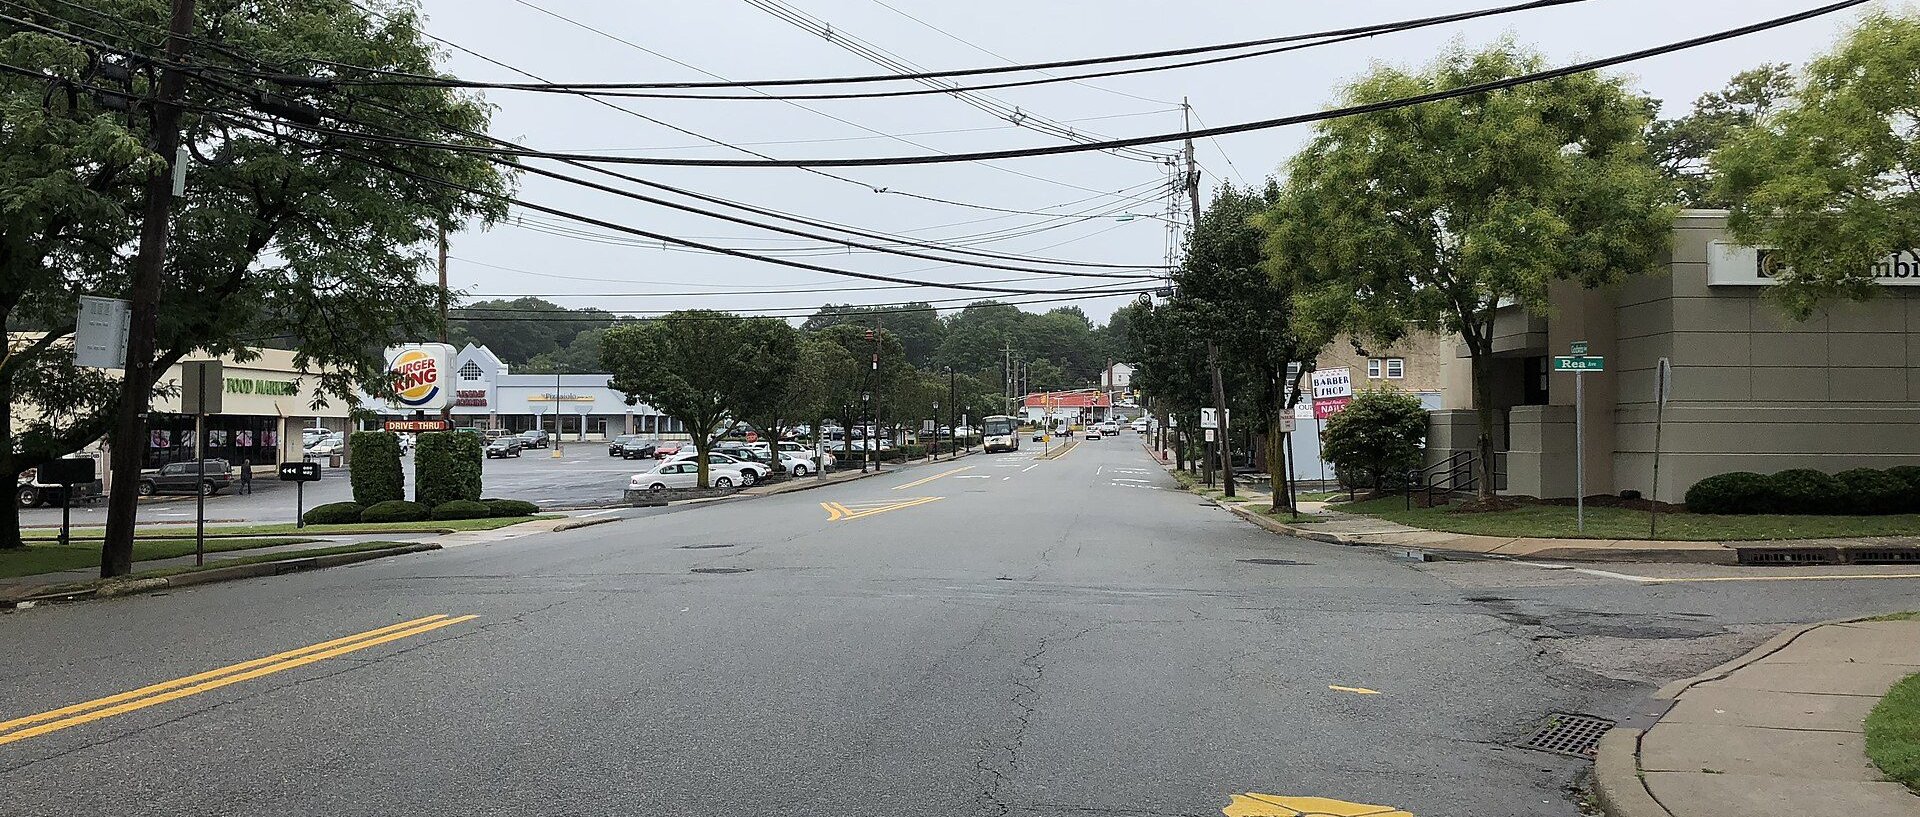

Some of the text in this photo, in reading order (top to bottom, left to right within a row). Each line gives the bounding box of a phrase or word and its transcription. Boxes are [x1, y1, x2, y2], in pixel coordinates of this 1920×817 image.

[1561, 359, 1586, 368] Rea
[393, 368, 437, 393] KING
[1313, 376, 1349, 387] BARBER
[226, 378, 254, 394] FOOD
[1321, 386, 1344, 396] SHOP
[389, 421, 440, 430] DRIVE THRU
